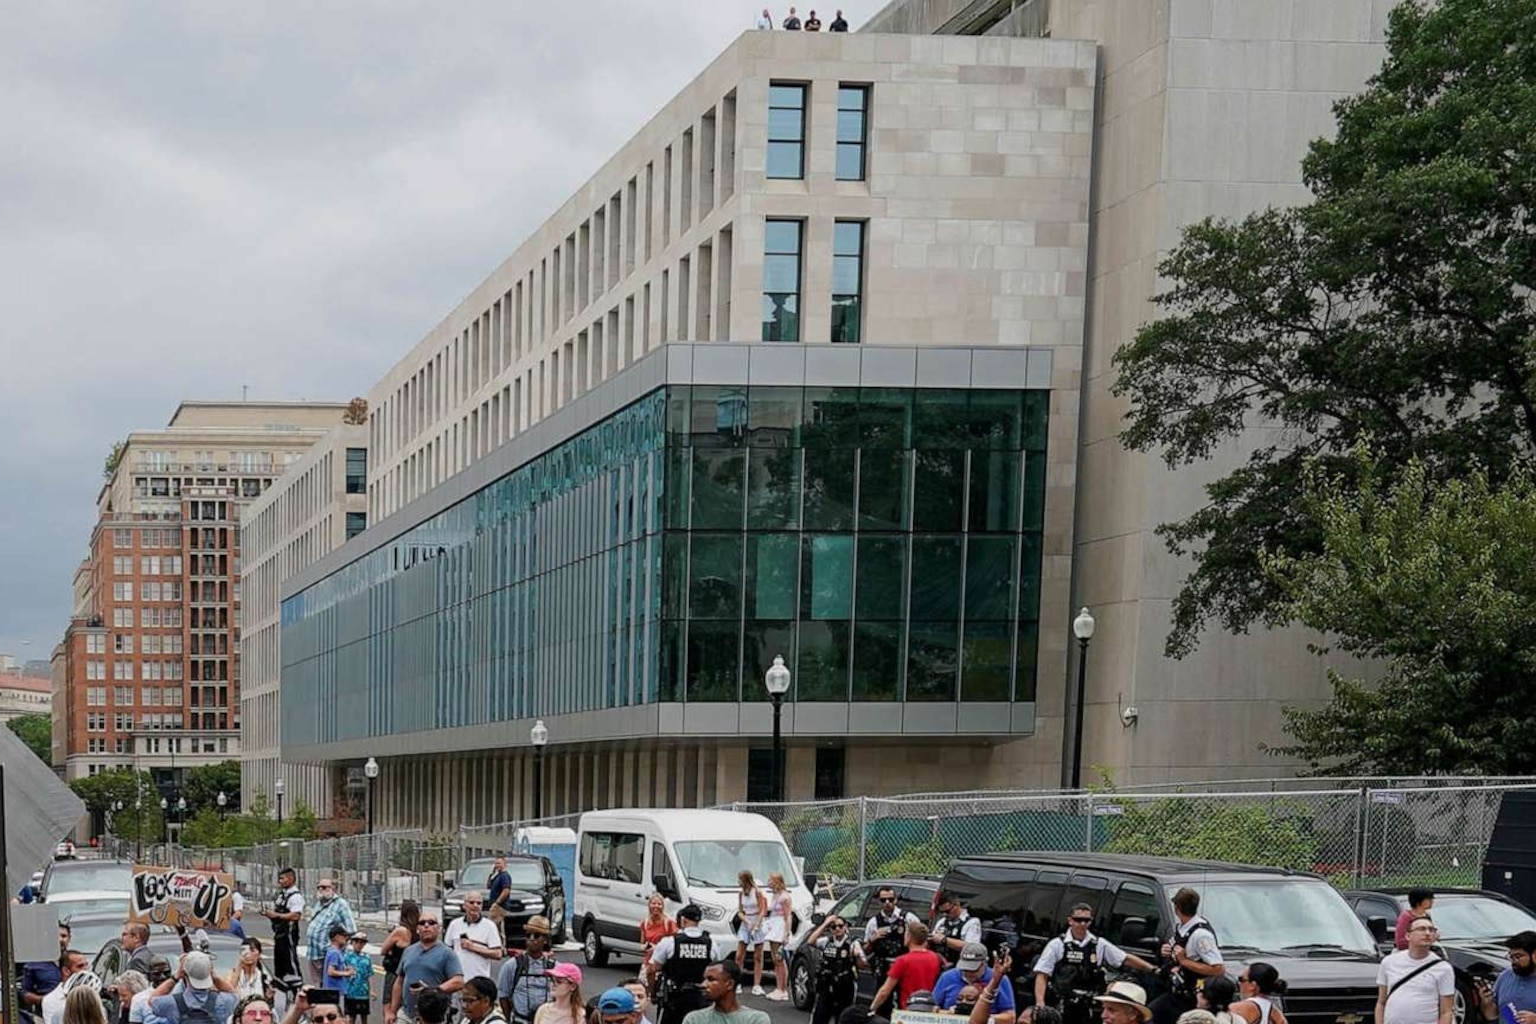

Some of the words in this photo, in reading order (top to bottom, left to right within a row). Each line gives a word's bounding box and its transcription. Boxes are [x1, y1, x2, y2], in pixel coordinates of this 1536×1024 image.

[134, 871, 175, 911] LOCK
[194, 875, 228, 925] UP
[679, 949, 708, 959] POLICE
